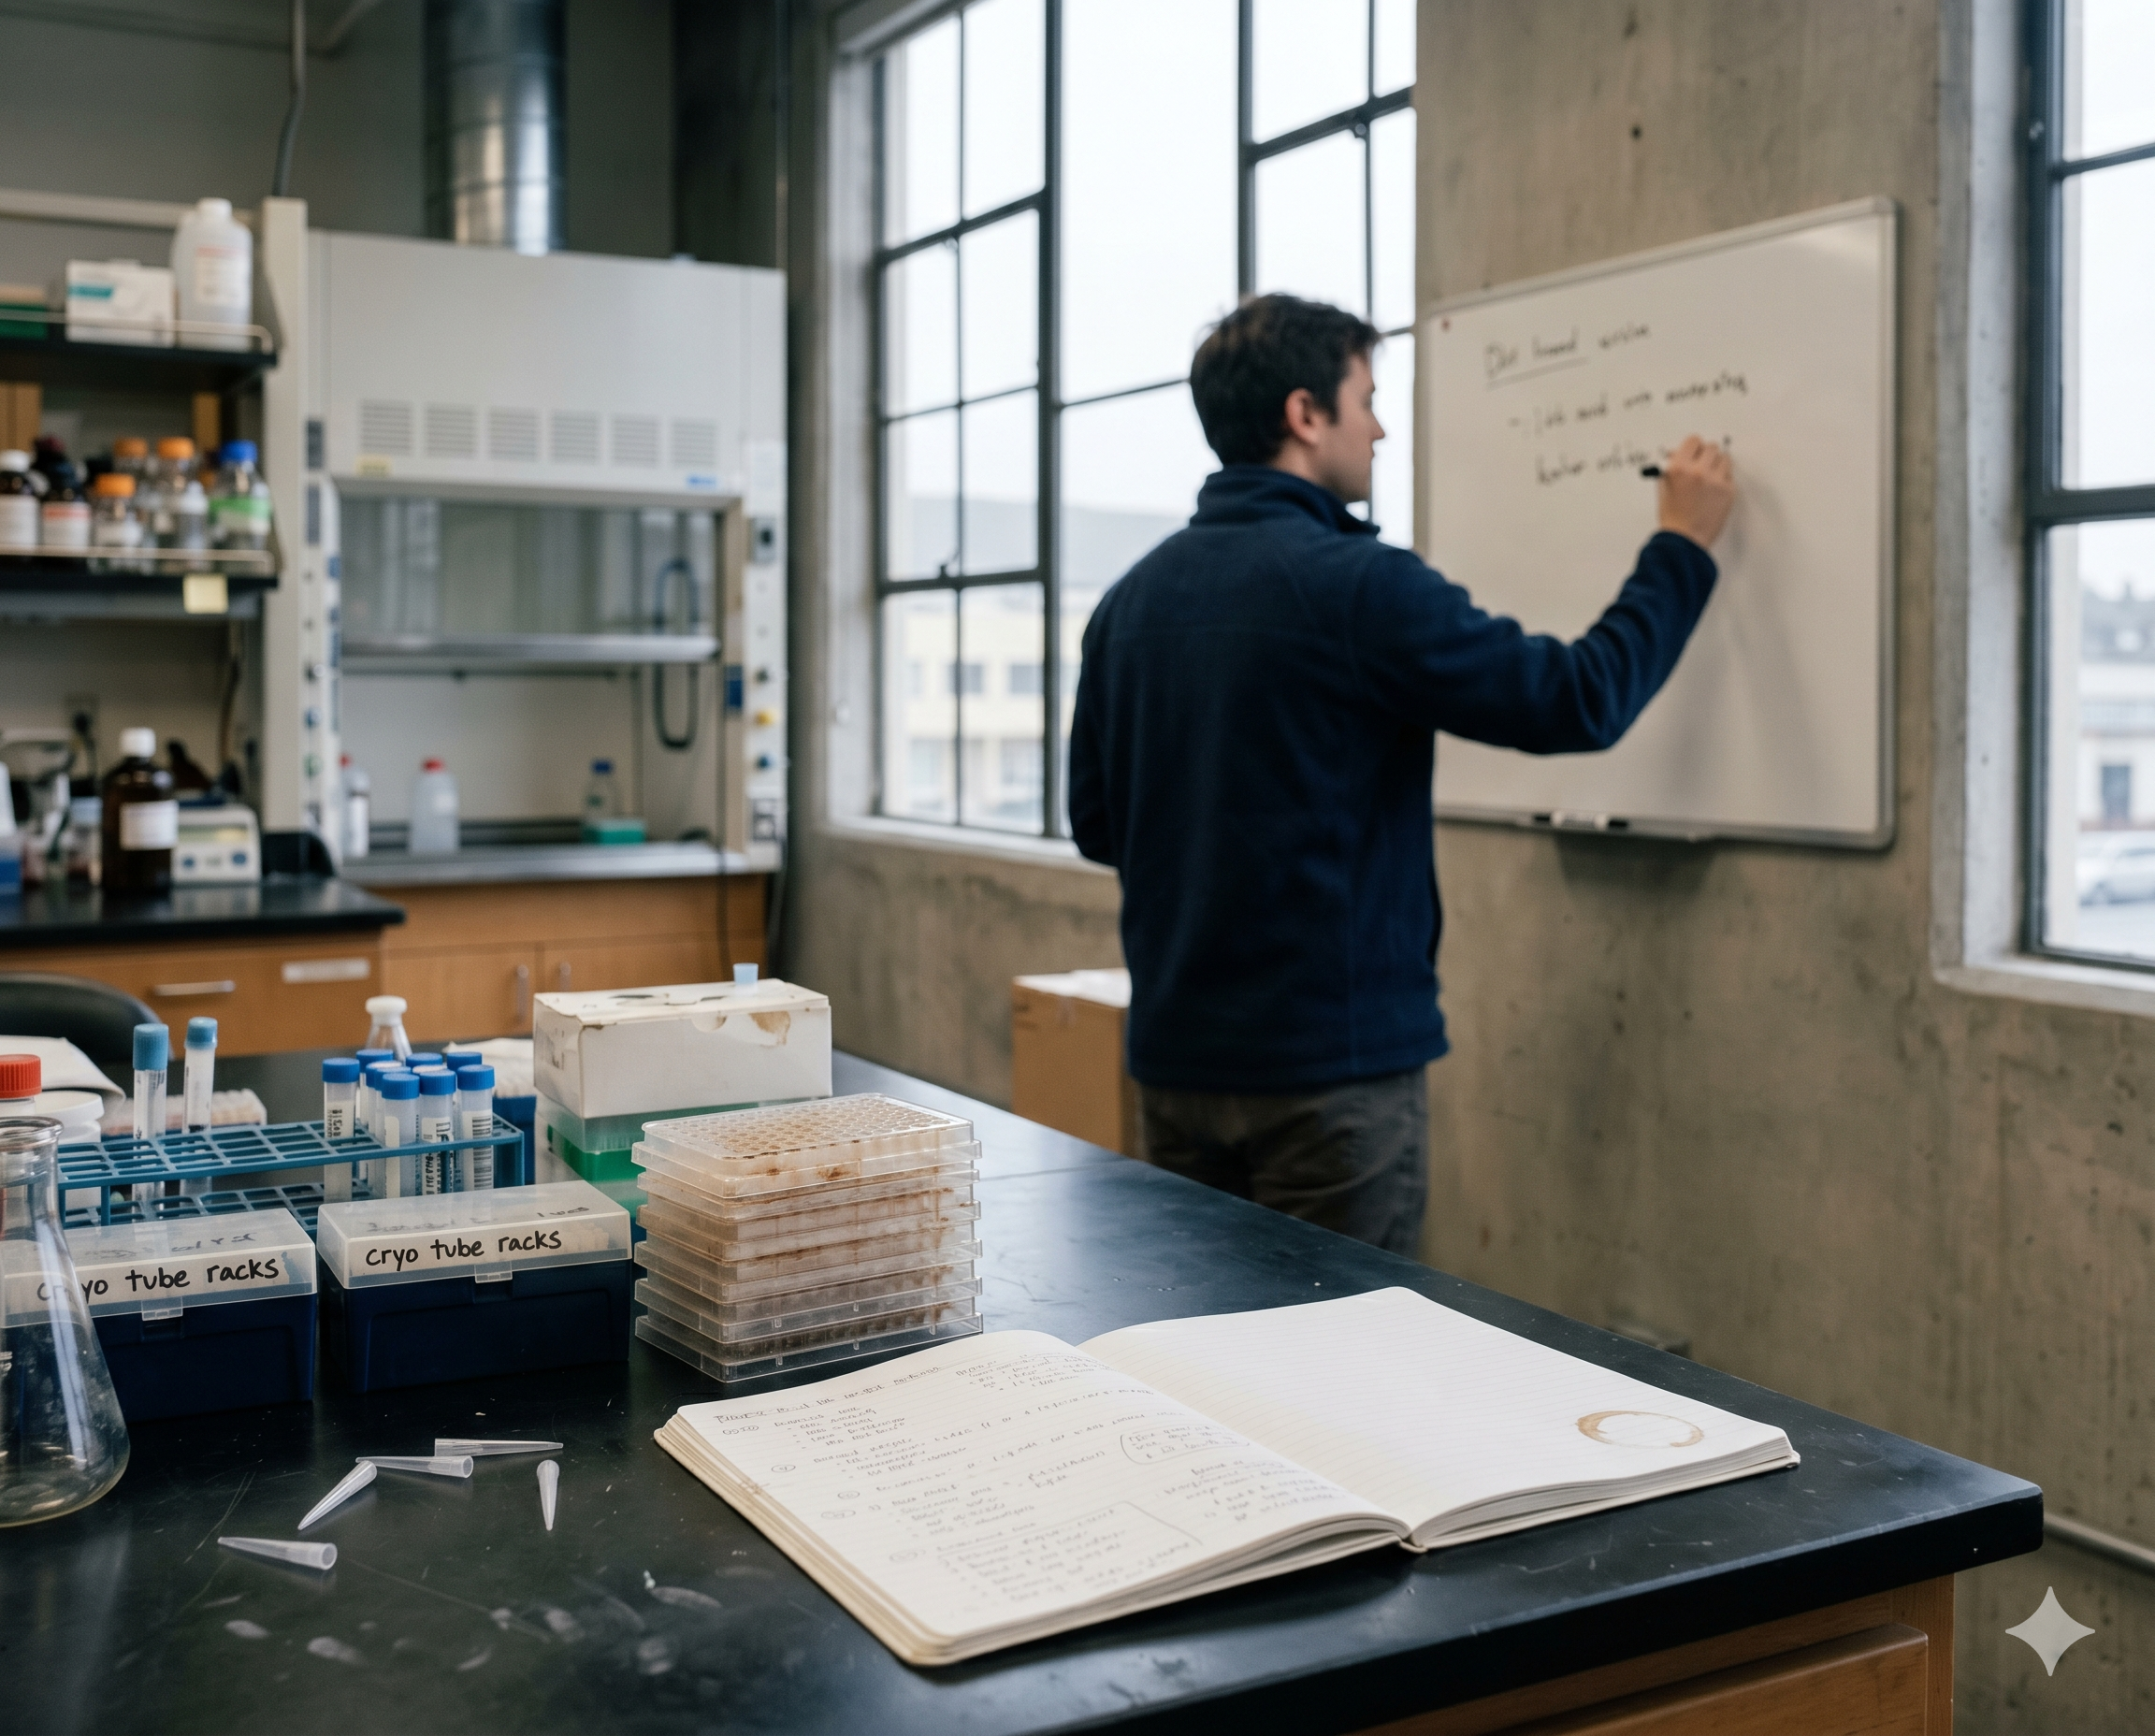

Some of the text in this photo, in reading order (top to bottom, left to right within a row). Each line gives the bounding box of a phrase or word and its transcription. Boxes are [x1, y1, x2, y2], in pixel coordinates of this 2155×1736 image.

[366, 1230, 562, 1271] cryo tube racks
[124, 1266, 191, 1292] tube
[206, 1257, 280, 1283] racks
